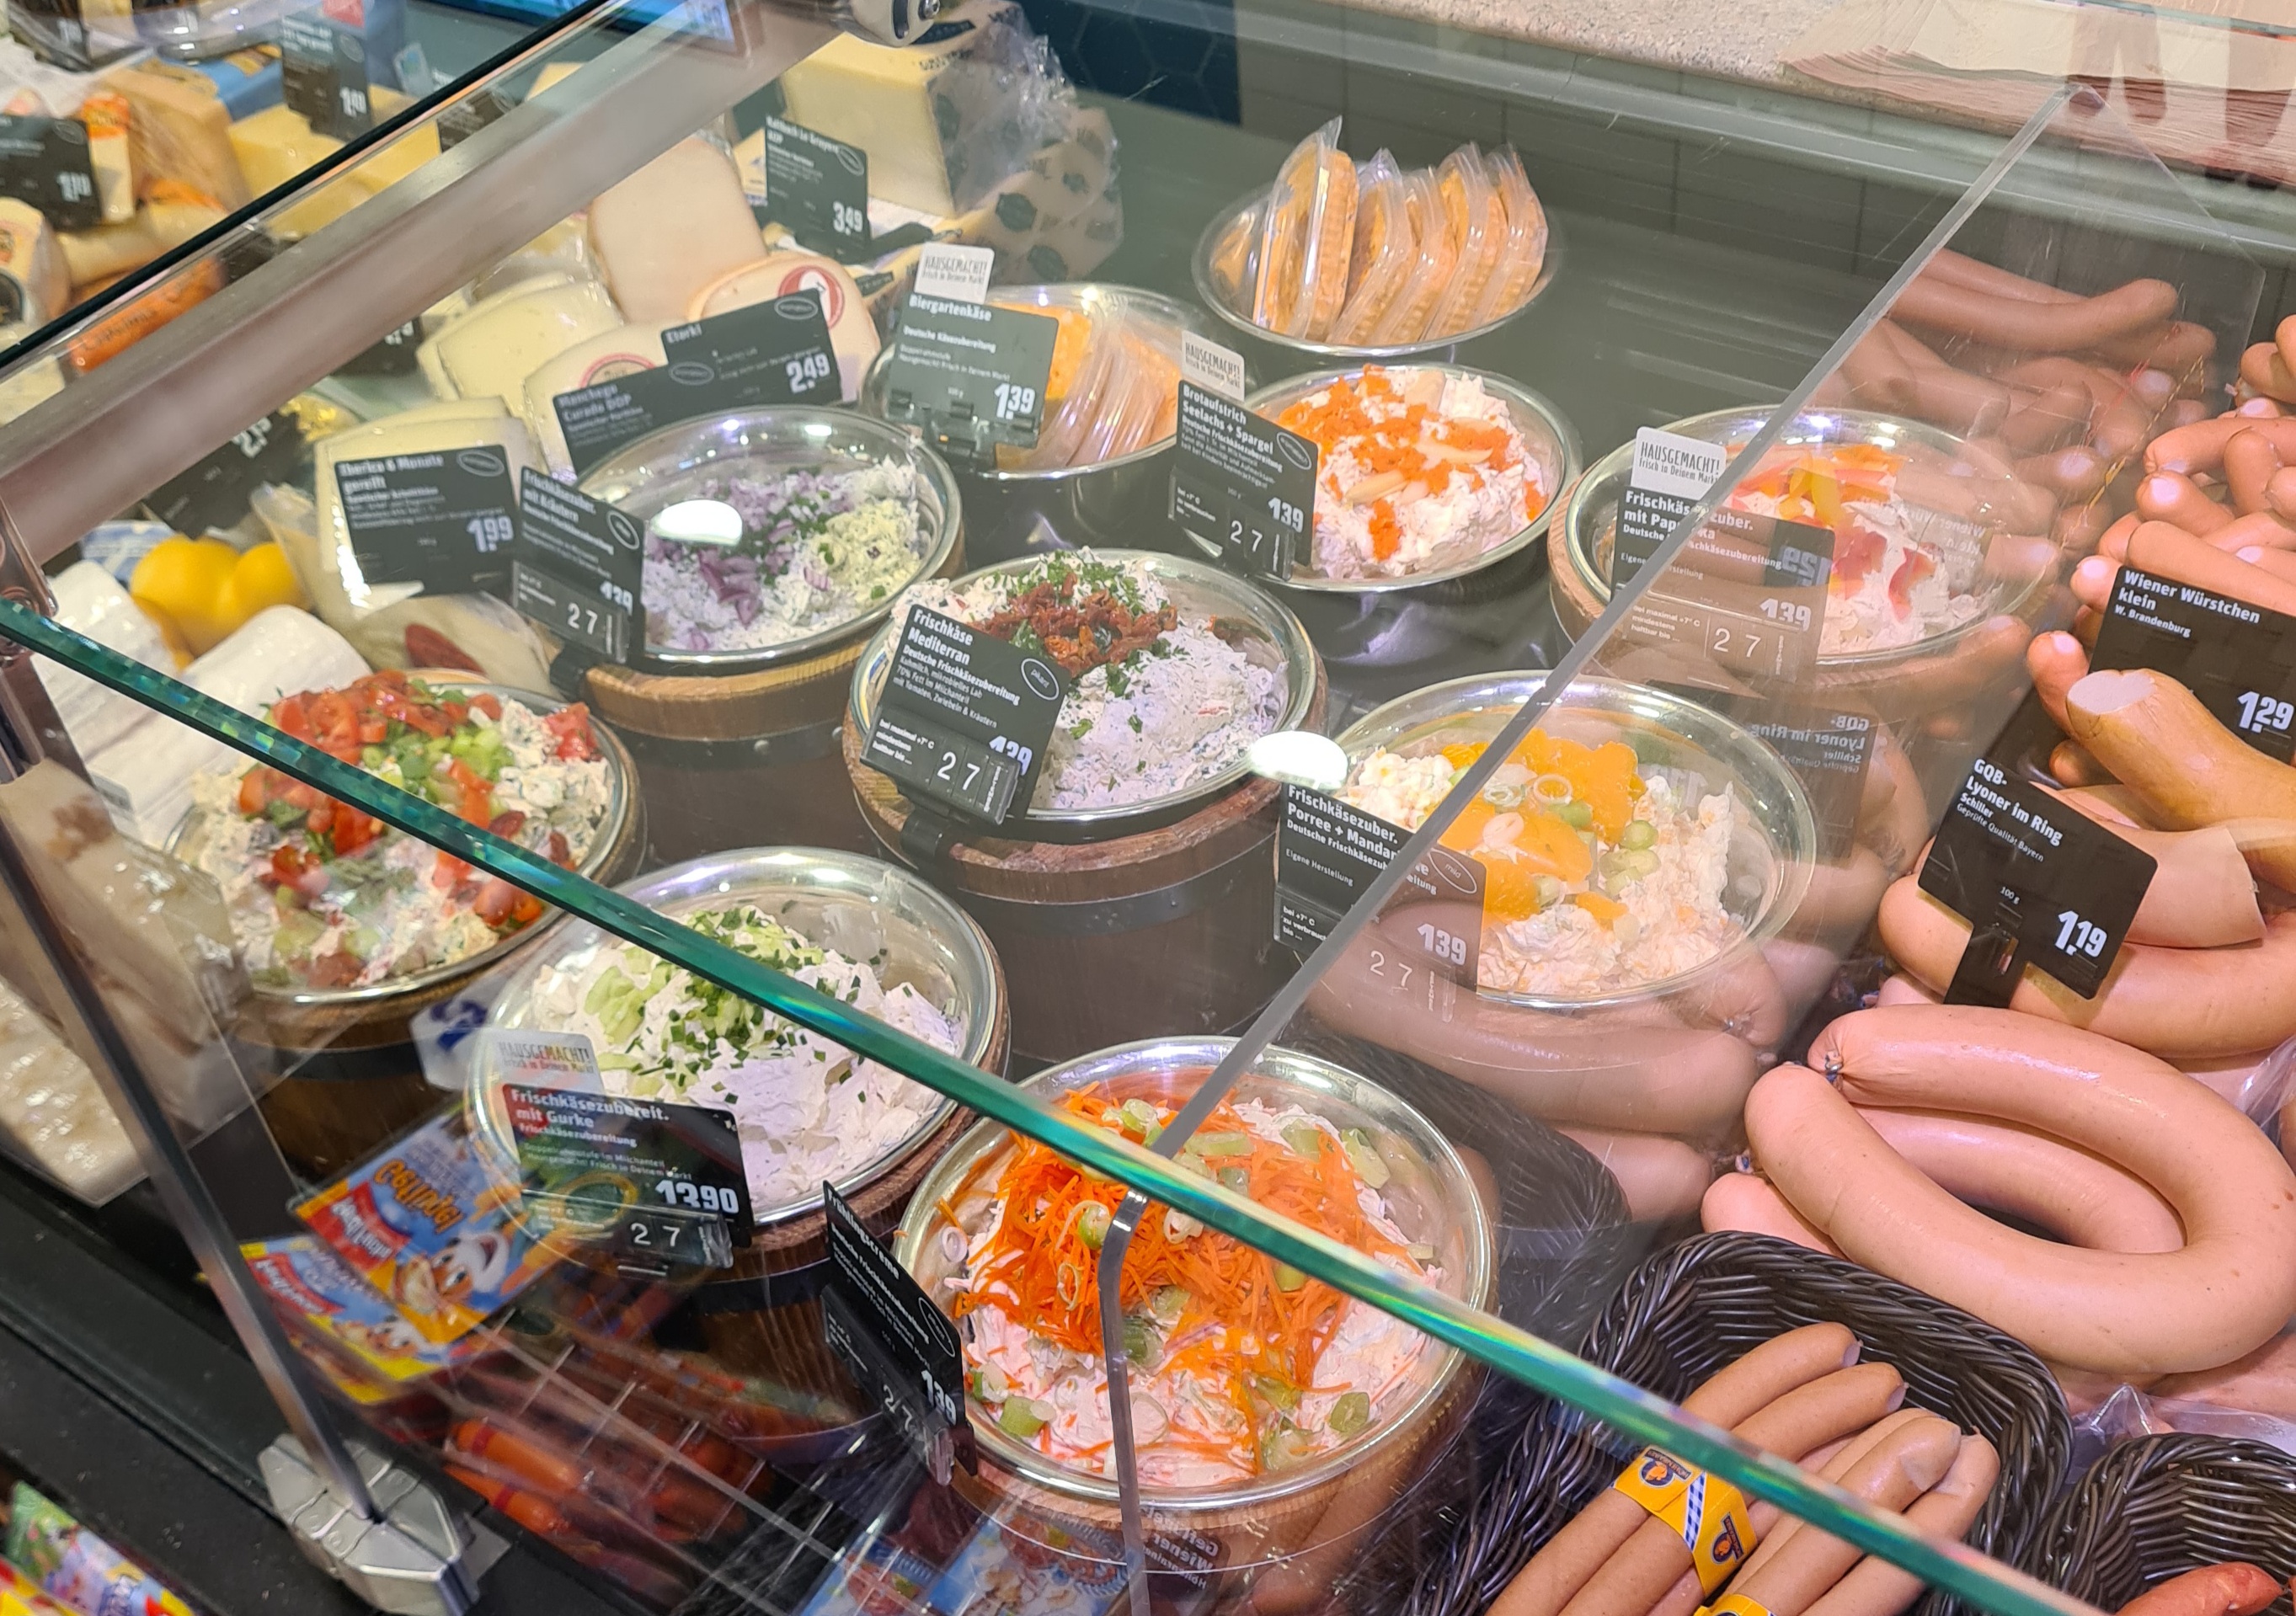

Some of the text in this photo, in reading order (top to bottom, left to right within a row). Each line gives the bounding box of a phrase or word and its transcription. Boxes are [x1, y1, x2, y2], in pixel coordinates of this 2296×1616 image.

[926, 256, 988, 275] HAUSGEMACHT!
[909, 295, 992, 322] Biergartenkäse
[786, 352, 831, 394] 2.49
[1185, 342, 1241, 376] HAUSGEMACHT!
[994, 383, 1036, 419] 1.39
[1183, 385, 1247, 424] Brotaufstrich
[1183, 401, 1225, 430] Seelachs
[1226, 424, 1233, 432] +
[1236, 426, 1273, 455] Spargel
[1639, 457, 1658, 472] Frisch
[1660, 463, 1668, 473] in
[1670, 465, 1696, 481] Deinem
[1641, 441, 1720, 475] HAUSGEMACHT!
[467, 515, 514, 552] 1.99
[1623, 524, 1665, 541] Deutsche
[1624, 509, 1647, 526] mit
[1231, 520, 1263, 552] 2 7
[2118, 587, 2157, 611] klein
[2124, 570, 2261, 624] Wiener Würstchen
[568, 602, 598, 635] 2 7
[913, 609, 974, 647] Frischkäse
[1631, 615, 1675, 632] mindestens
[1646, 607, 1678, 622] maximal
[2114, 605, 2192, 638] W. Brandenburg
[907, 627, 970, 665] Mediterran
[1713, 628, 1731, 653] 2
[1745, 634, 1762, 658] 7
[903, 644, 1021, 706] Deutsche Frischkäsezubereitung
[934, 680, 969, 703] Milchanteil
[933, 691, 962, 712] Zwiebeln
[970, 685, 983, 699] Lab
[2237, 691, 2294, 733] 1.29
[937, 751, 957, 781] 2
[962, 763, 980, 791] 7
[1974, 758, 2008, 787] GQB-
[1288, 802, 1332, 833] Porree
[1334, 825, 1344, 836] +
[1289, 785, 1398, 844] Frischkäsezuber.
[1960, 792, 1994, 819] Schiller
[1966, 776, 2063, 847] Lyoner im Ring
[1287, 819, 1327, 843] Deutsche
[1957, 803, 2044, 862] Geprüfte Qualität Bayern
[1286, 848, 1354, 887] Eigene Herstellung
[1445, 862, 1461, 879] mild
[1283, 905, 1295, 915] bei
[2000, 886, 2021, 905] 100 g
[2055, 910, 2107, 958] 1.19
[1370, 950, 1412, 987] 2 7
[511, 1090, 670, 1121] Frischkäsezubereit.
[516, 1107, 594, 1129] mit Gurke
[631, 1223, 651, 1245] 2
[662, 1225, 681, 1247] 7
[827, 1189, 900, 1280] Frühlingscreme
